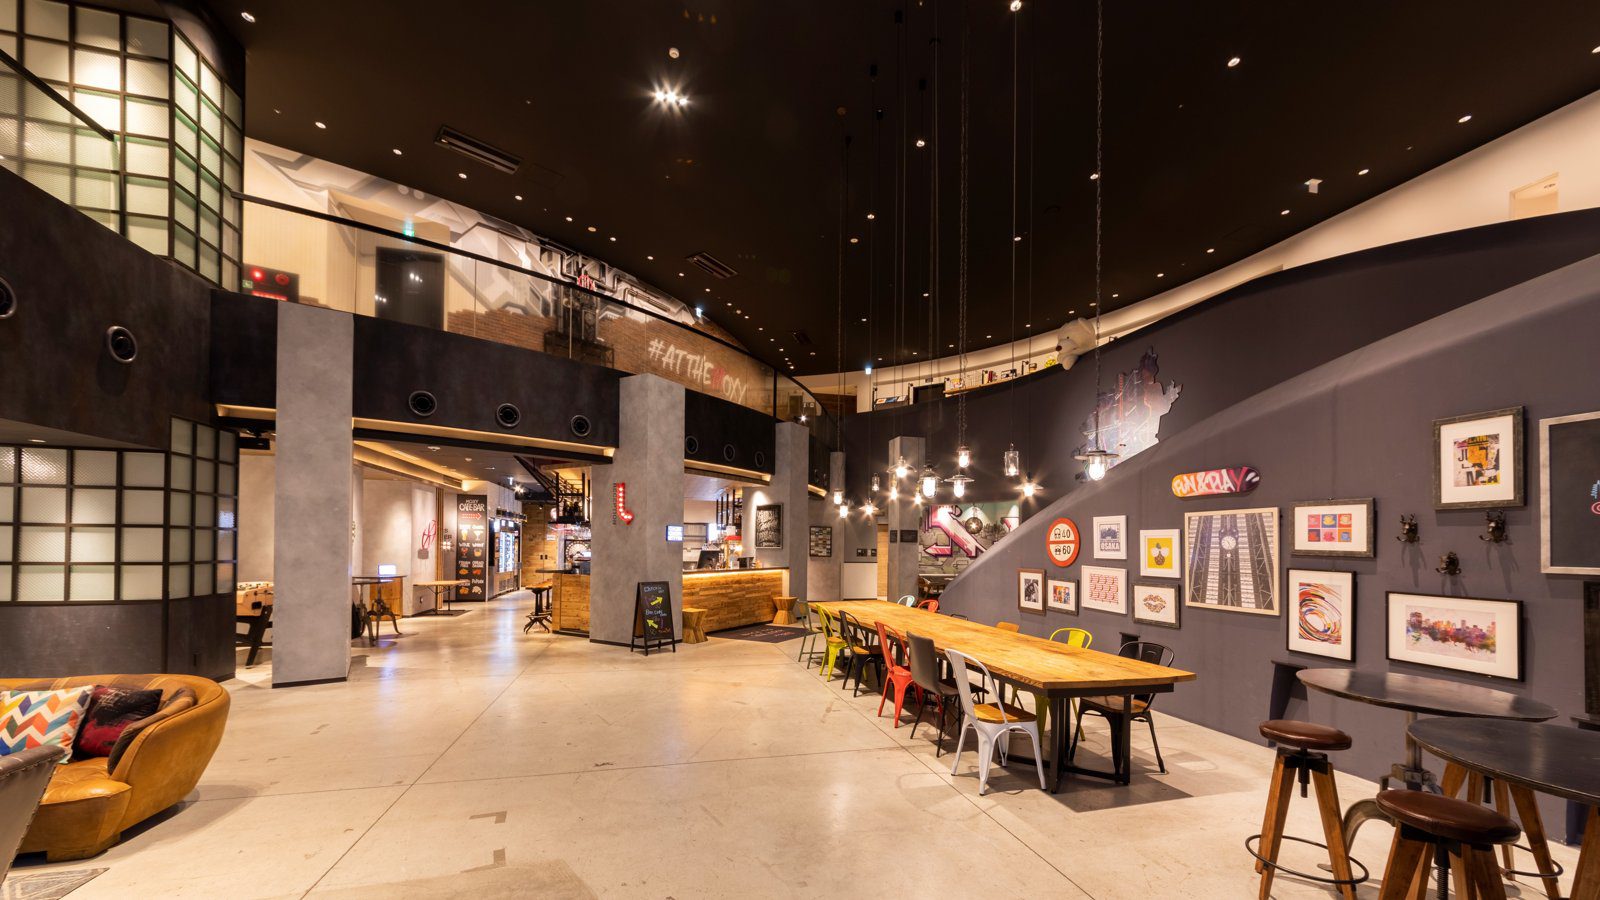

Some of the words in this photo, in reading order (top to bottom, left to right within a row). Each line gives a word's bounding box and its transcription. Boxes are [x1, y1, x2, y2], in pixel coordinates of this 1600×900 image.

[1062, 529, 1071, 539] 40
[1062, 545, 1071, 555] 60
[1100, 542, 1120, 550] OSAKA
